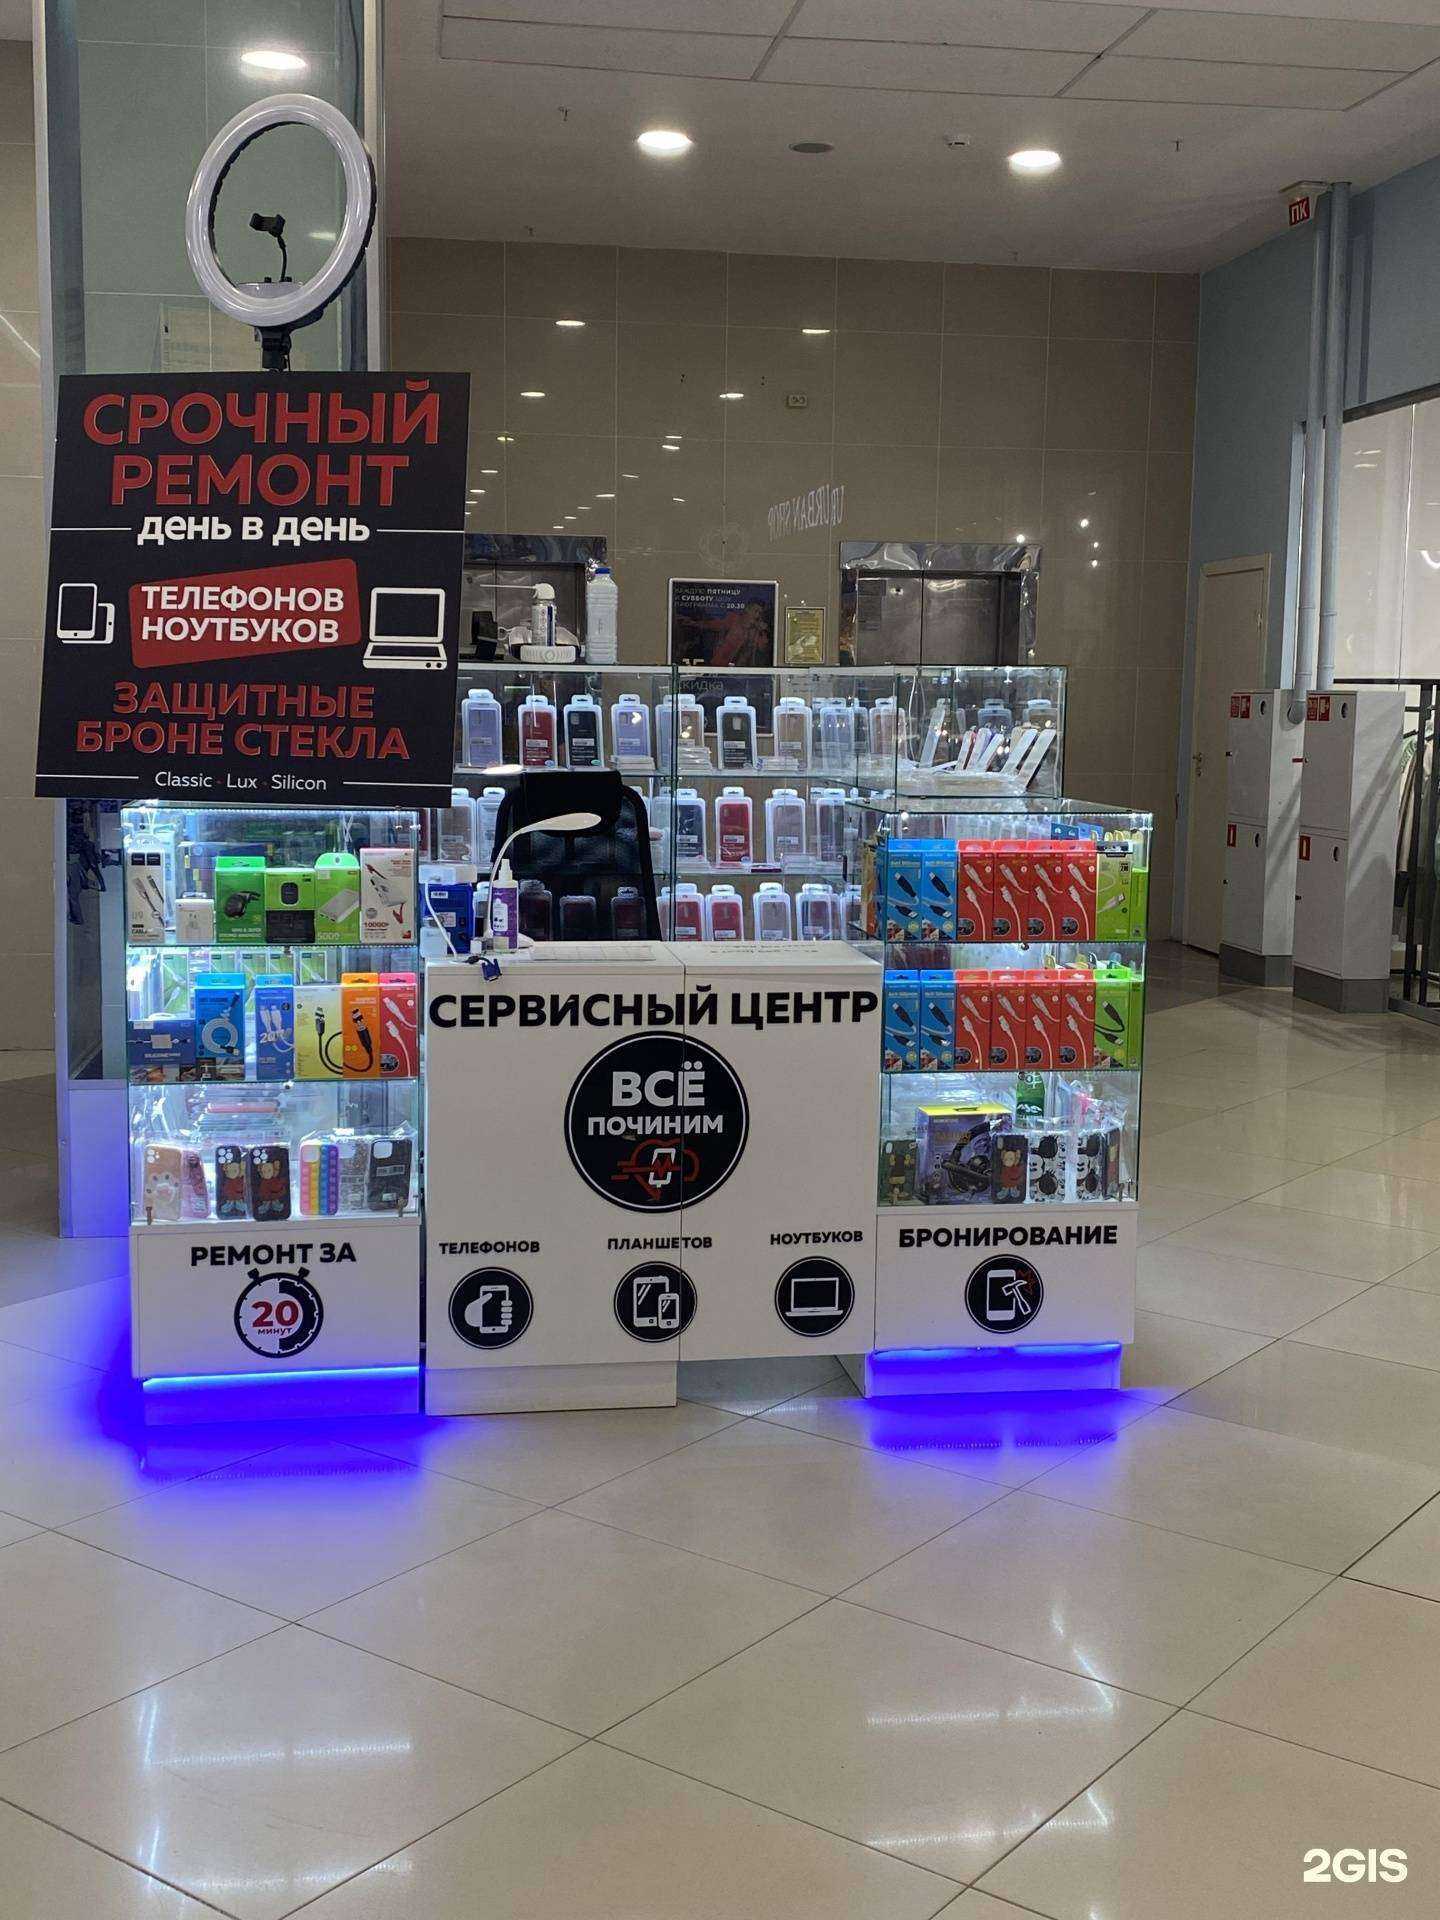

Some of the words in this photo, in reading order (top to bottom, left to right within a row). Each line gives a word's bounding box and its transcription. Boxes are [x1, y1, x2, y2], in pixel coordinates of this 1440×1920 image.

[1291, 200, 1308, 223] ПК
[83, 378, 440, 446] СРОЧНЫЙ
[111, 454, 410, 506] РЕМОНТ
[141, 585, 344, 612] ТЕЛЕФОНОВ
[141, 617, 339, 643] НОУТБУКОВ
[113, 682, 375, 720] ЗАЩИТНЫЕ
[76, 721, 224, 756] БРОНЕ
[235, 725, 410, 760] СТЕКЛА
[155, 771, 212, 788] Classic
[226, 774, 258, 789] Lux
[271, 774, 327, 791] Silicon
[428, 985, 718, 1028] СЕРВИСНЫЙ
[731, 990, 878, 1031] ЦЕНТР
[612, 1061, 706, 1107] ВСЁ
[439, 1240, 541, 1255] ТЕЛЕФОНОВ
[607, 1236, 713, 1250] ПЛАНШЕТОВ
[770, 1231, 864, 1246] НОУТБУКОВ
[899, 1225, 1118, 1248] БРОНИРОВАНИЕ
[191, 1244, 313, 1266] РЕМОНТ
[320, 1242, 356, 1263] ЗА
[252, 1300, 299, 1327] 20
